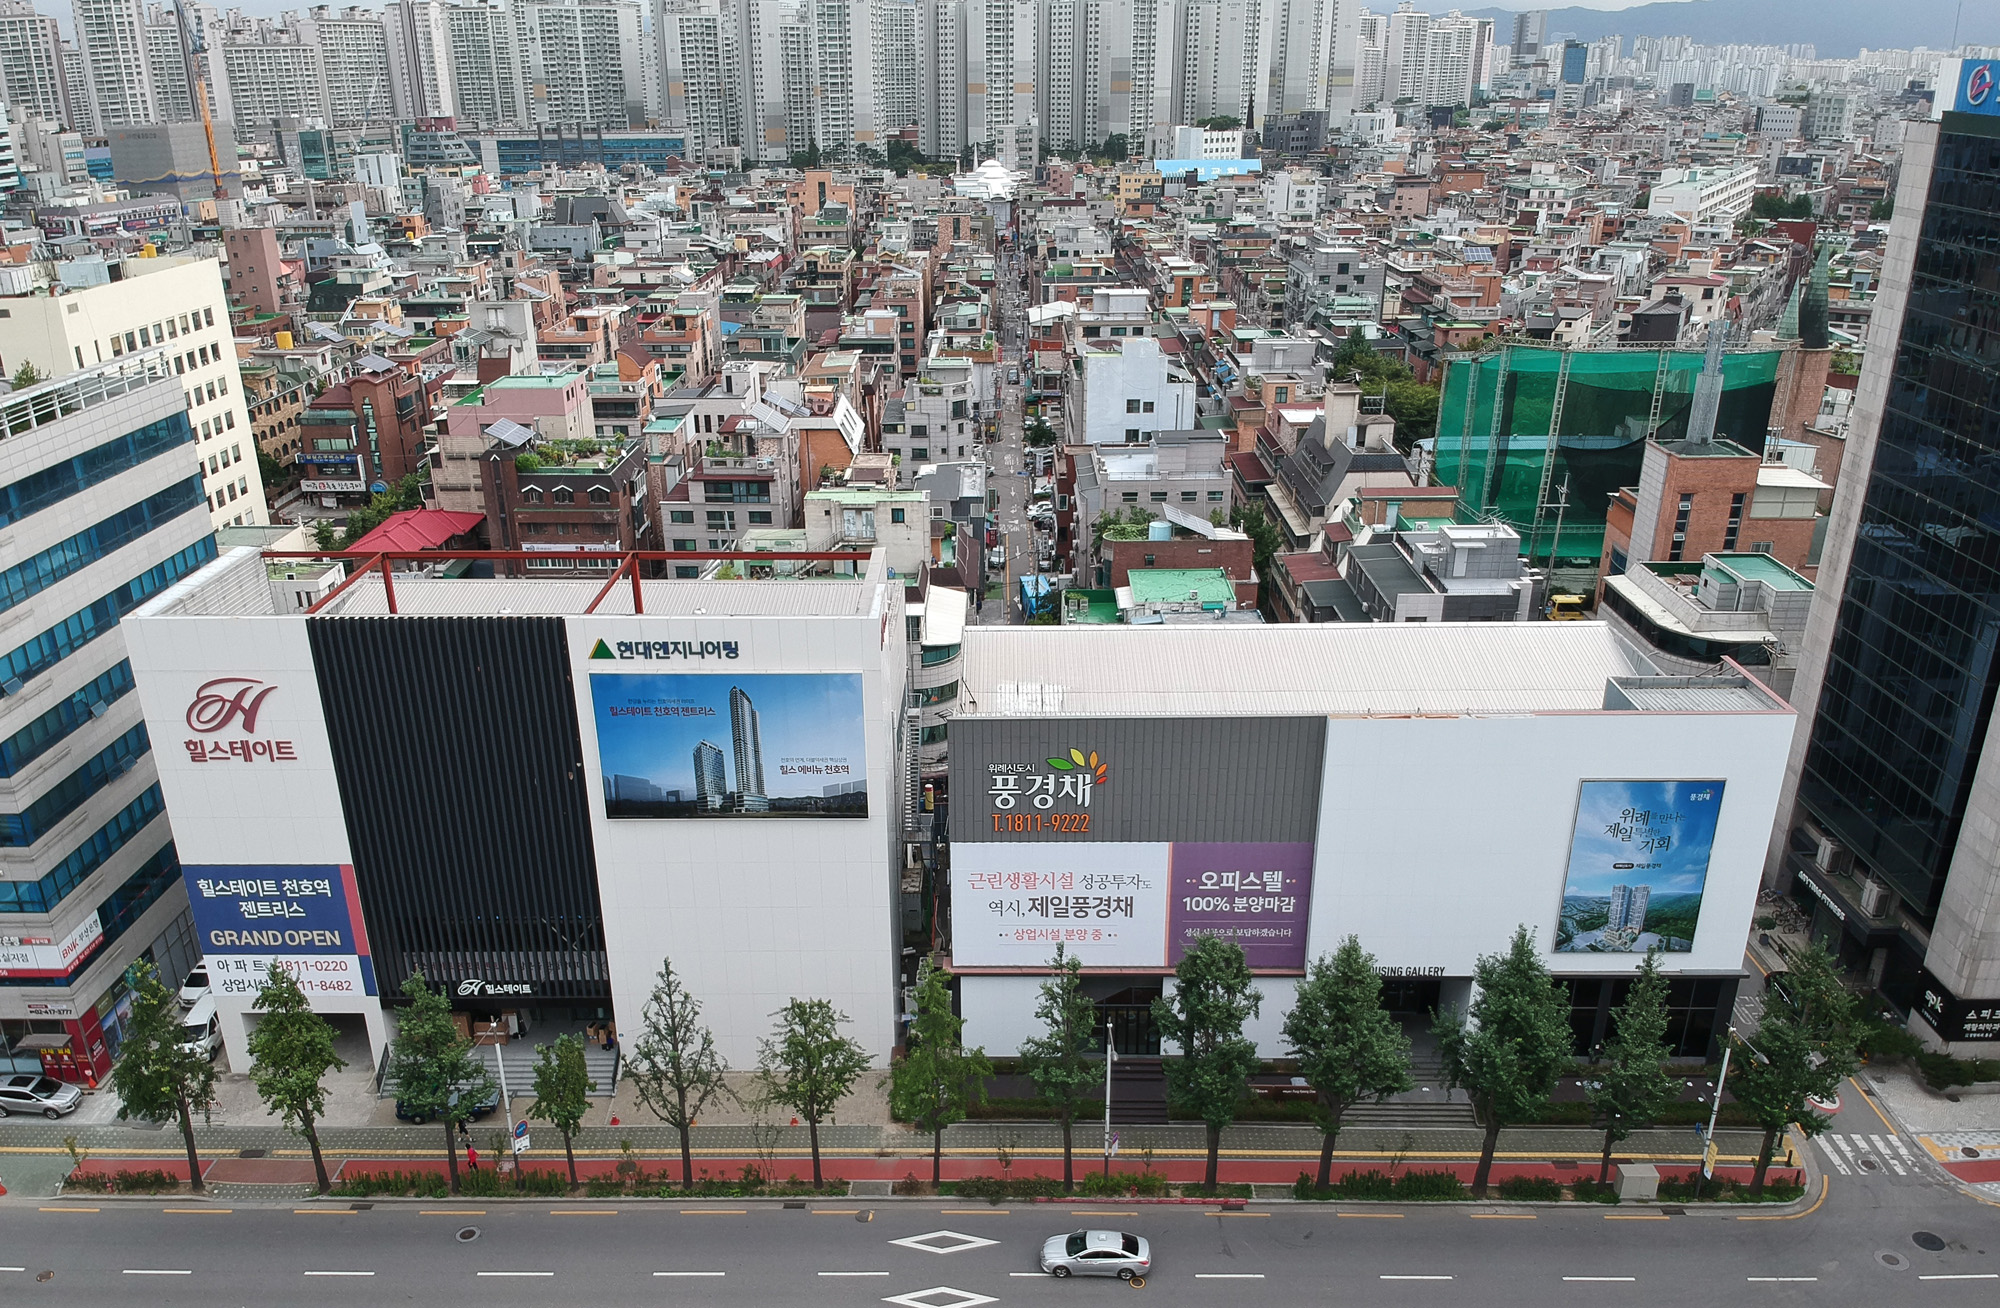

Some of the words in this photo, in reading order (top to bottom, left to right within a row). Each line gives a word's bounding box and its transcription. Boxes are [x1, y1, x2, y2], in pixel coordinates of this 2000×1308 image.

[616, 641, 740, 660] 현대엔지니어링
[609, 706, 652, 717] 힐스테이트
[653, 706, 680, 717] 천호역
[680, 706, 716, 717] 젠트리스
[184, 739, 297, 763] 힐스테이트
[779, 764, 797, 775] 힐스
[797, 764, 823, 775] 에비뉴
[824, 764, 850, 775] 천호역
[988, 763, 1035, 774] 위례신도시
[988, 774, 1092, 809] 풍경채
[992, 813, 1090, 832] T.1811-9222
[1603, 822, 1634, 842] 제일
[1638, 835, 1671, 854] 기회
[196, 879, 280, 898] 힐스테이트
[282, 879, 331, 898] 천호역
[968, 872, 1074, 890] 근린생활시설
[1079, 873, 1152, 890] 성공투자도
[1198, 870, 1283, 892] 오피스텔
[238, 901, 306, 918] 젠트리스
[988, 899, 1026, 918] 역시,
[1027, 896, 1134, 918] 제일풍경채
[1182, 896, 1231, 912] 100%
[1233, 896, 1296, 913] 분양마감
[210, 930, 283, 946] GRAND
[284, 930, 341, 946] OPEN
[1013, 928, 1061, 941] 상업시설
[1064, 929, 1088, 941] 분양
[1091, 929, 1103, 941] 중
[1236, 927, 1293, 938] 보답하겠습니다
[61, 938, 79, 959] BNK
[278, 960, 348, 972] 1811-0220
[1405, 966, 1446, 977] GALLERY
[485, 984, 532, 994] 힐스테이트
